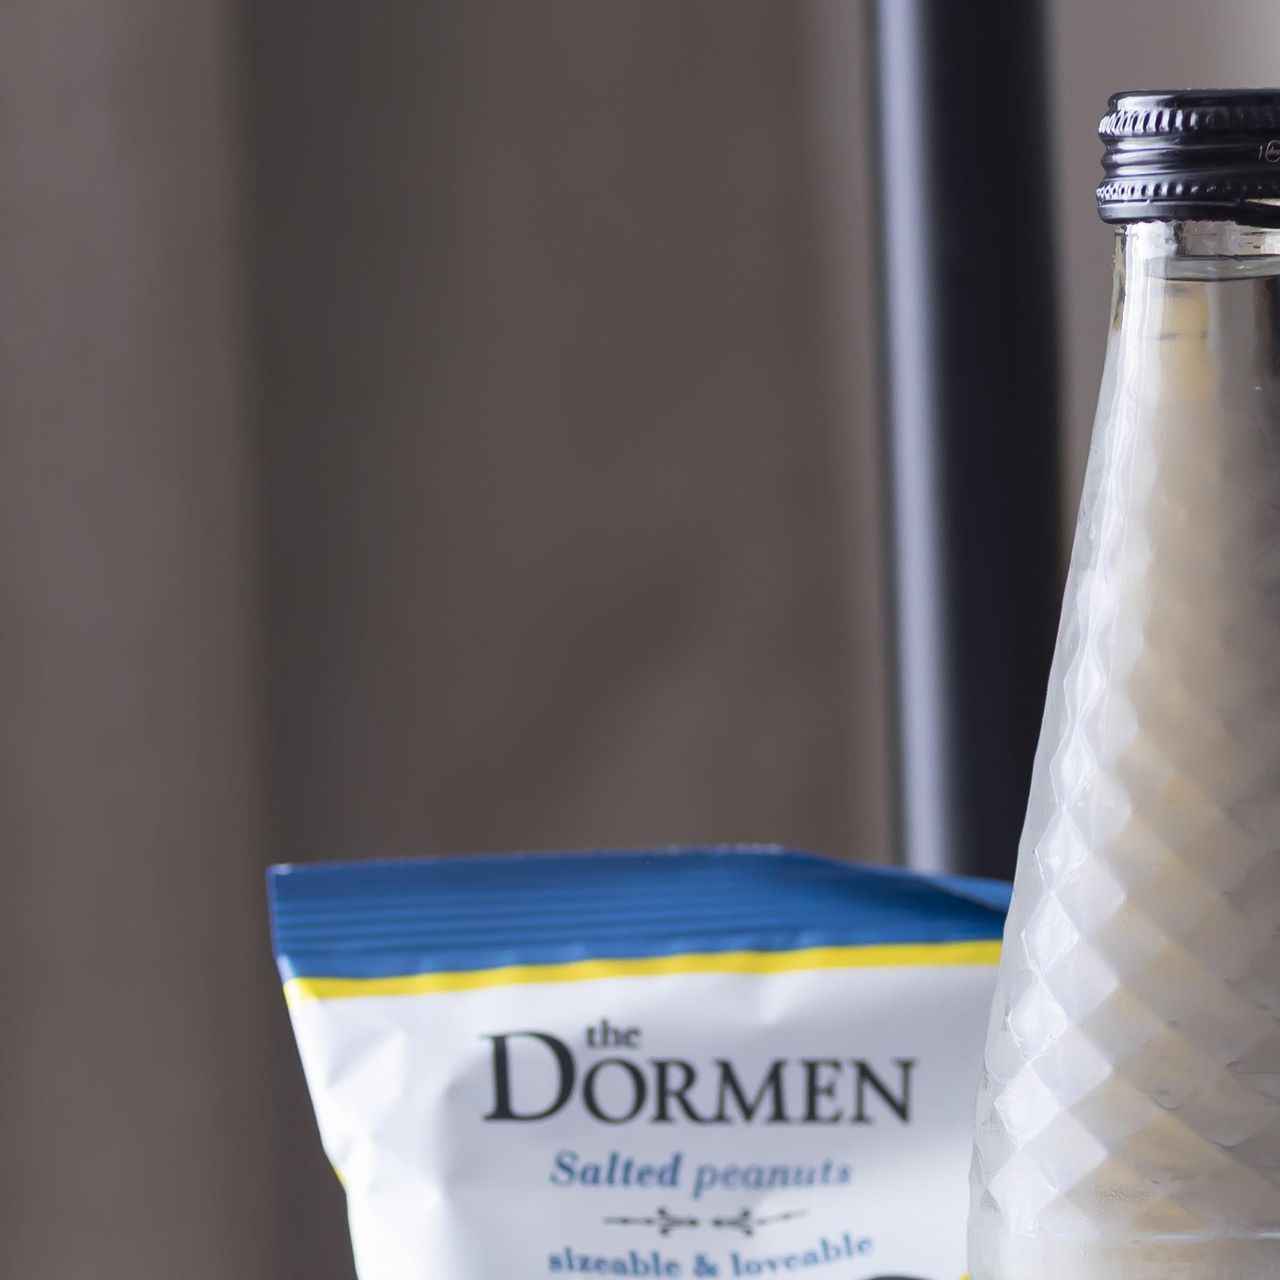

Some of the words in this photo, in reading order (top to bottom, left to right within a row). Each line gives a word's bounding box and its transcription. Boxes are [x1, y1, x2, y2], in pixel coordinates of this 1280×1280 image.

[587, 1019, 641, 1051] the
[482, 1030, 916, 1125] DORMEN
[549, 1151, 683, 1189] Salted
[693, 1157, 852, 1198] peanuts
[548, 1247, 682, 1280] sizeable
[694, 1256, 720, 1278] &
[731, 1231, 874, 1277] loveable
